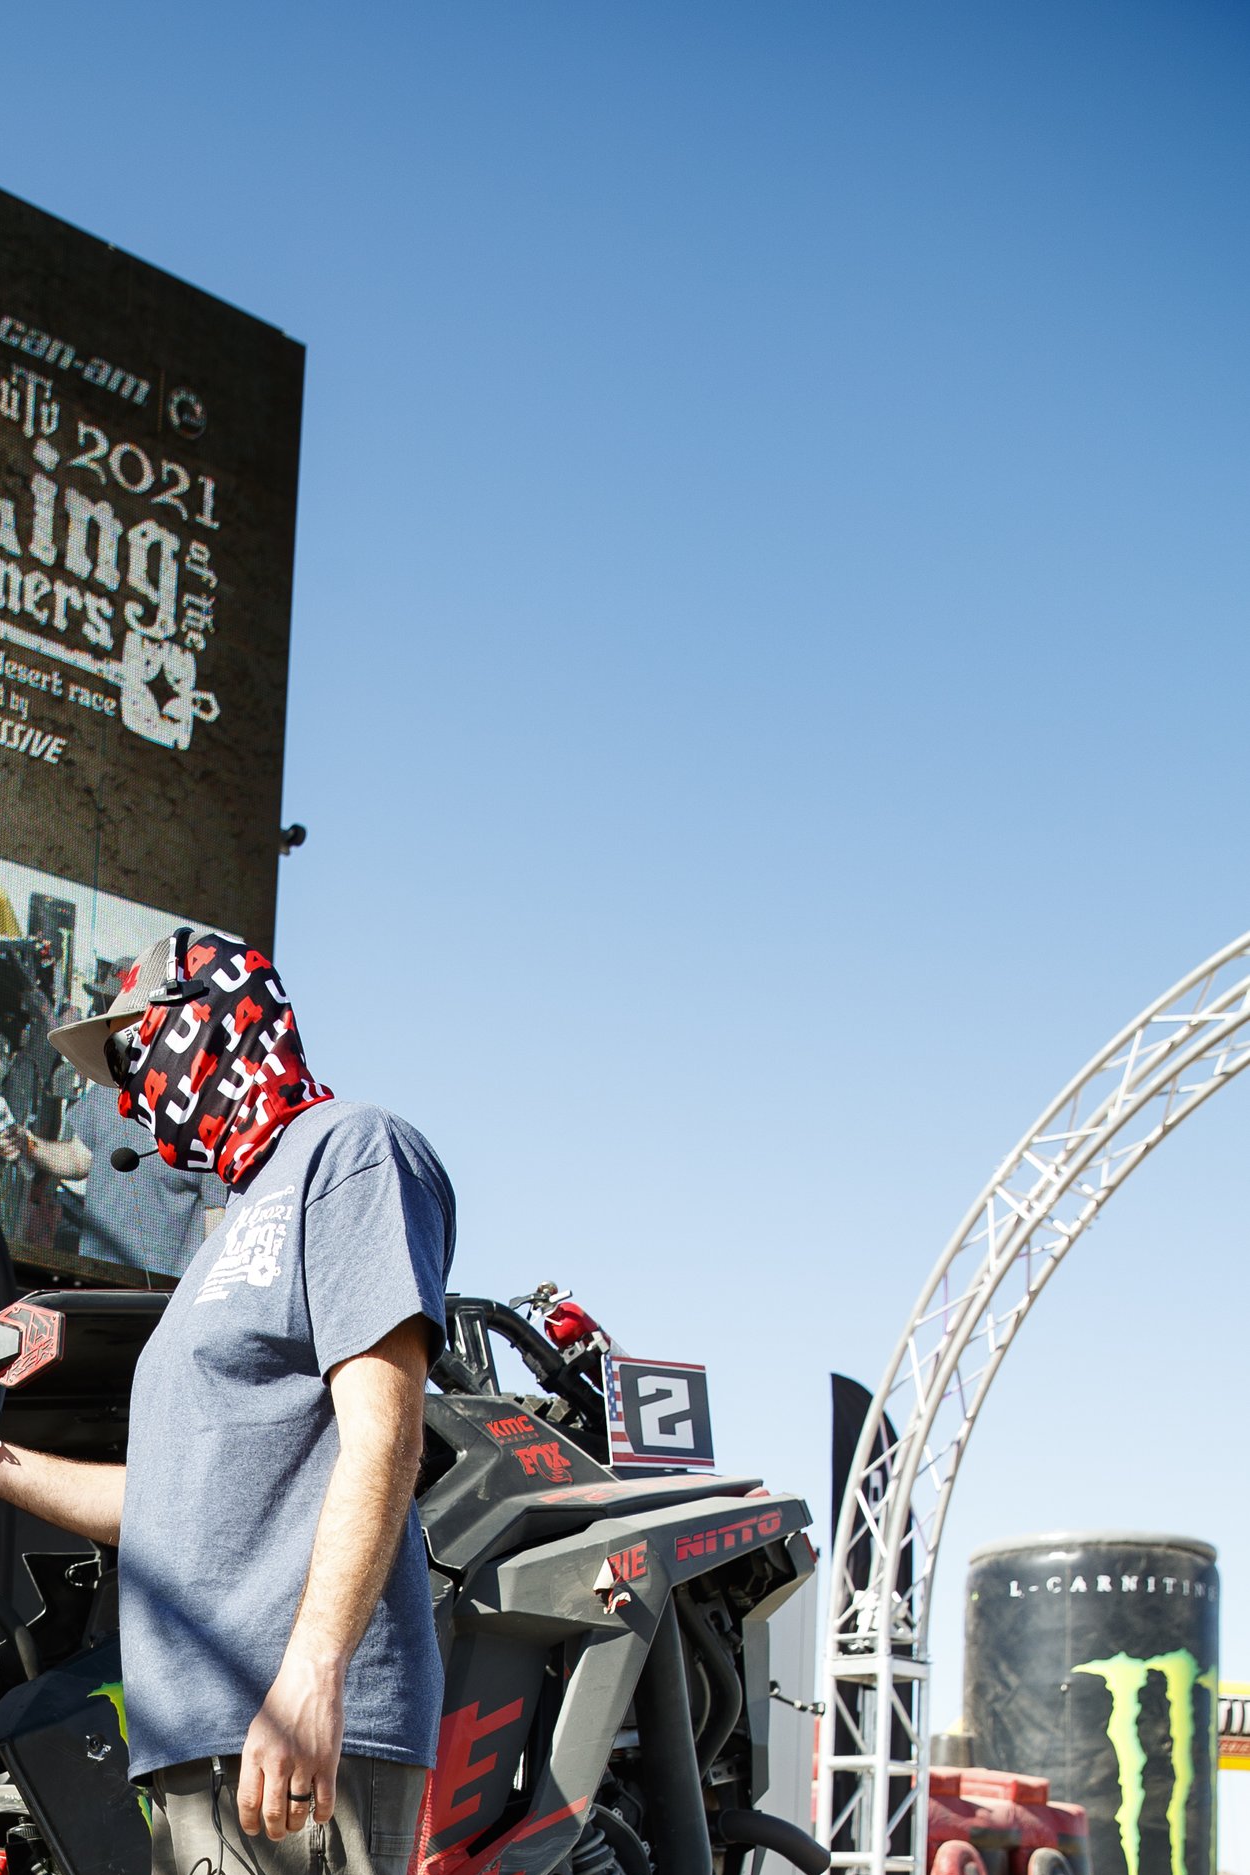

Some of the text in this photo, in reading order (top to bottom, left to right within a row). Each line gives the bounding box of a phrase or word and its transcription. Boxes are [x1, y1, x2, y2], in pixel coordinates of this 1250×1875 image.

[69, 421, 220, 530] 2021
[68, 683, 118, 717] race
[485, 1414, 535, 1438] KMC
[637, 1374, 695, 1450] 2
[513, 1441, 574, 1484] FOX
[675, 1510, 783, 1564] NITTO
